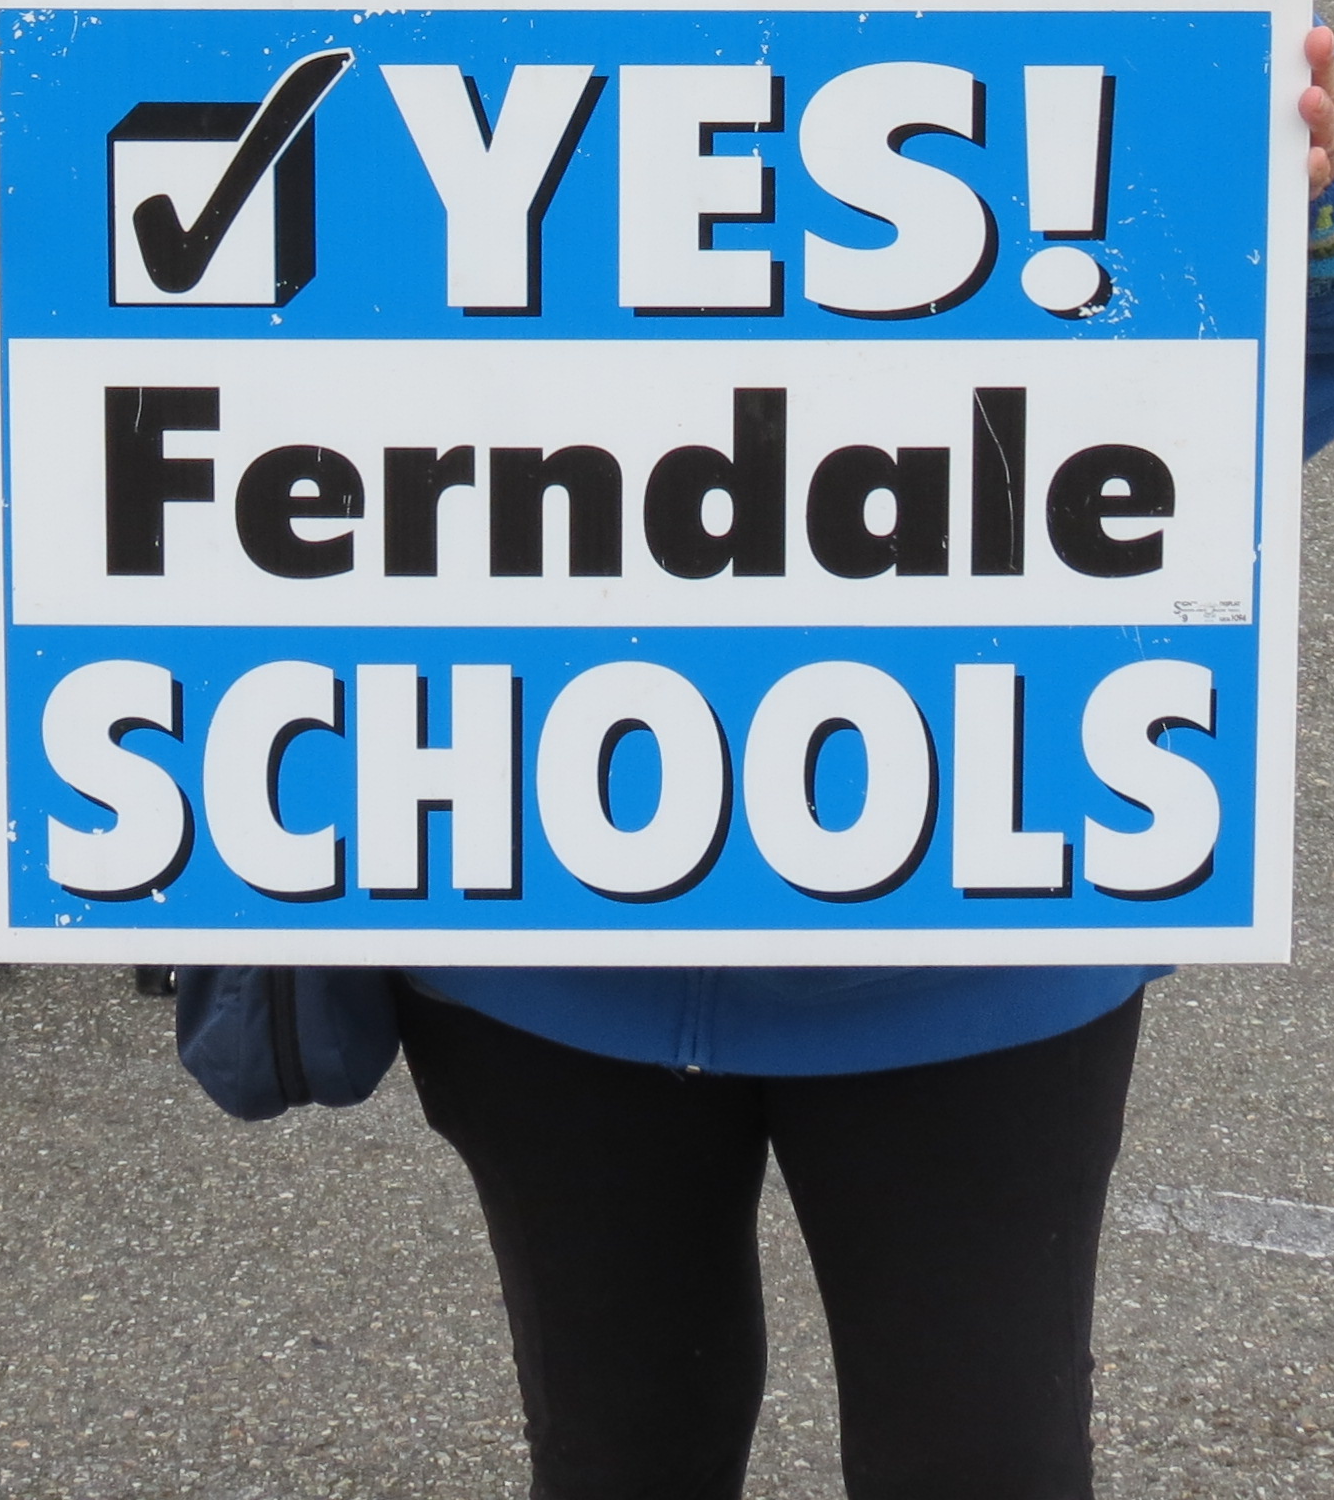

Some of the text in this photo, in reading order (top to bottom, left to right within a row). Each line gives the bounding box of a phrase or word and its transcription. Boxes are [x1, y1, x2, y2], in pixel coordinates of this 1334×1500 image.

[380, 60, 1115, 319] YES!
[105, 387, 1175, 579] Ferndale
[41, 659, 1220, 903] SCHOOLS
